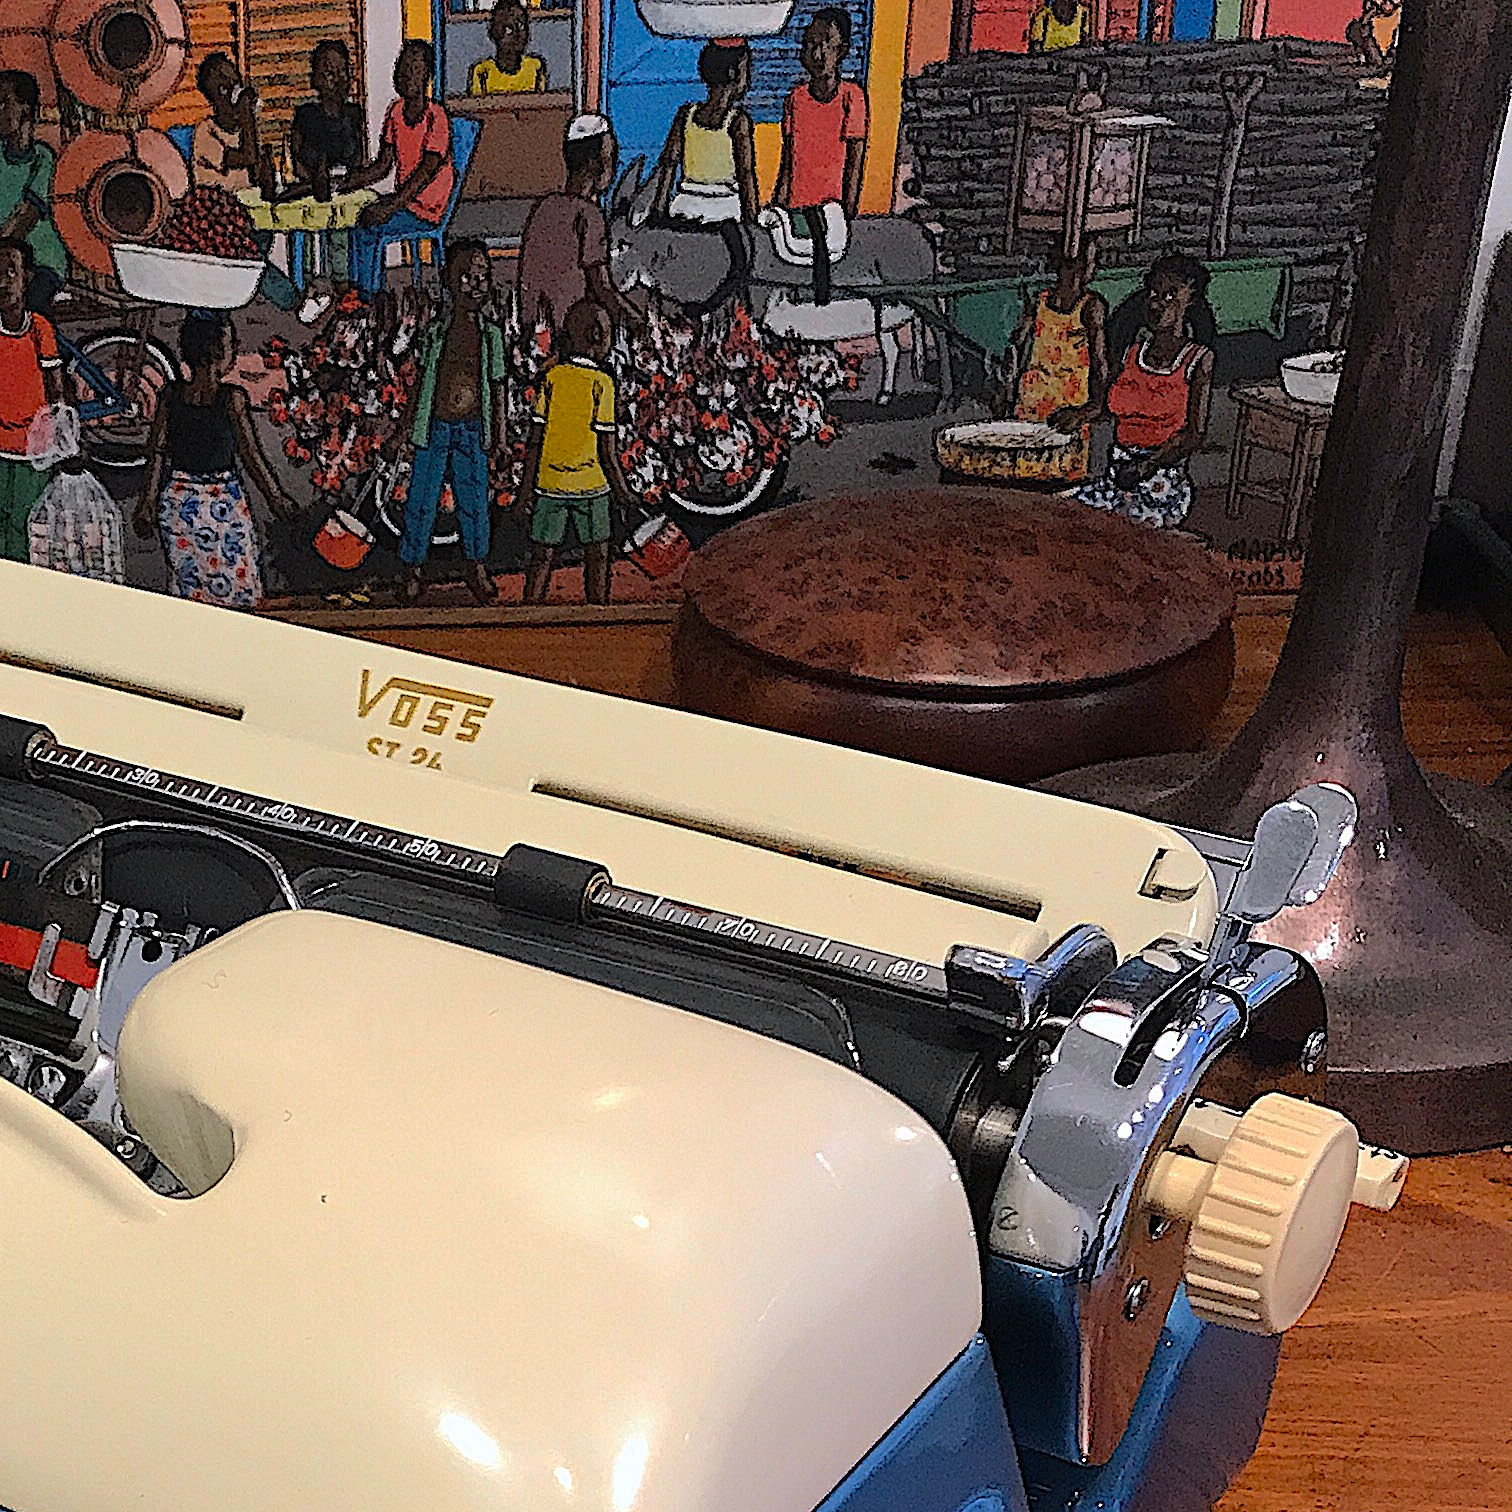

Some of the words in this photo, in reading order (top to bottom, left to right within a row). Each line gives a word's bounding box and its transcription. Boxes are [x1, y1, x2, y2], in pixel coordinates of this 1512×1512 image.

[358, 669, 493, 743] VOSS
[132, 768, 159, 784] 30
[266, 804, 294, 820] 40
[408, 839, 439, 856] 50
[721, 918, 755, 937] 70
[892, 960, 928, 981] 80
